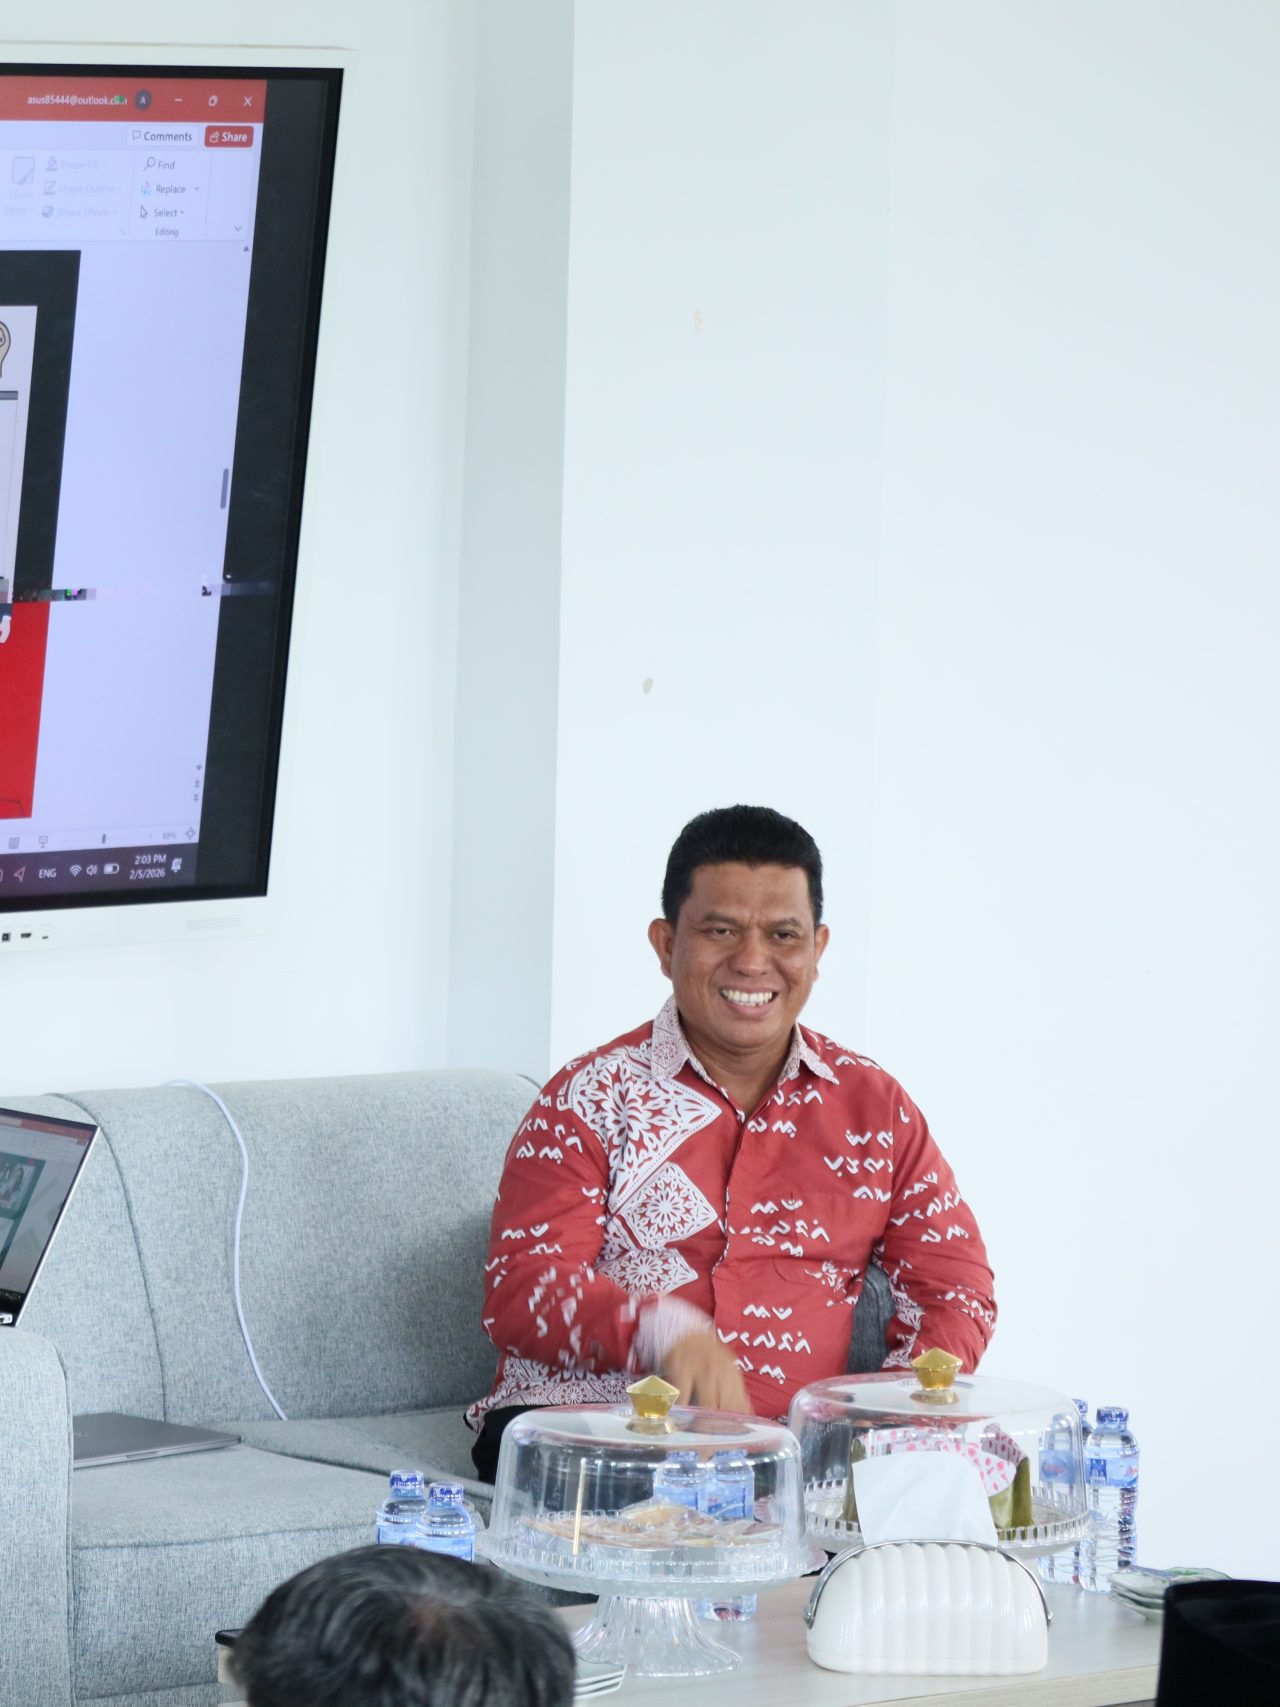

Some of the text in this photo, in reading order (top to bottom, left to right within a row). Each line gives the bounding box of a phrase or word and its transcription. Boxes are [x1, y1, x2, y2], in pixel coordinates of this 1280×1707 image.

[144, 131, 192, 142] Comments
[222, 132, 247, 142] Share
[158, 160, 175, 170] Find
[156, 185, 186, 195] Replace
[154, 208, 177, 217] Select
[155, 228, 179, 239] Editing
[134, 854, 167, 865] 2:03 PM
[38, 868, 57, 879] ENG
[129, 868, 166, 880] 2/5/2026
